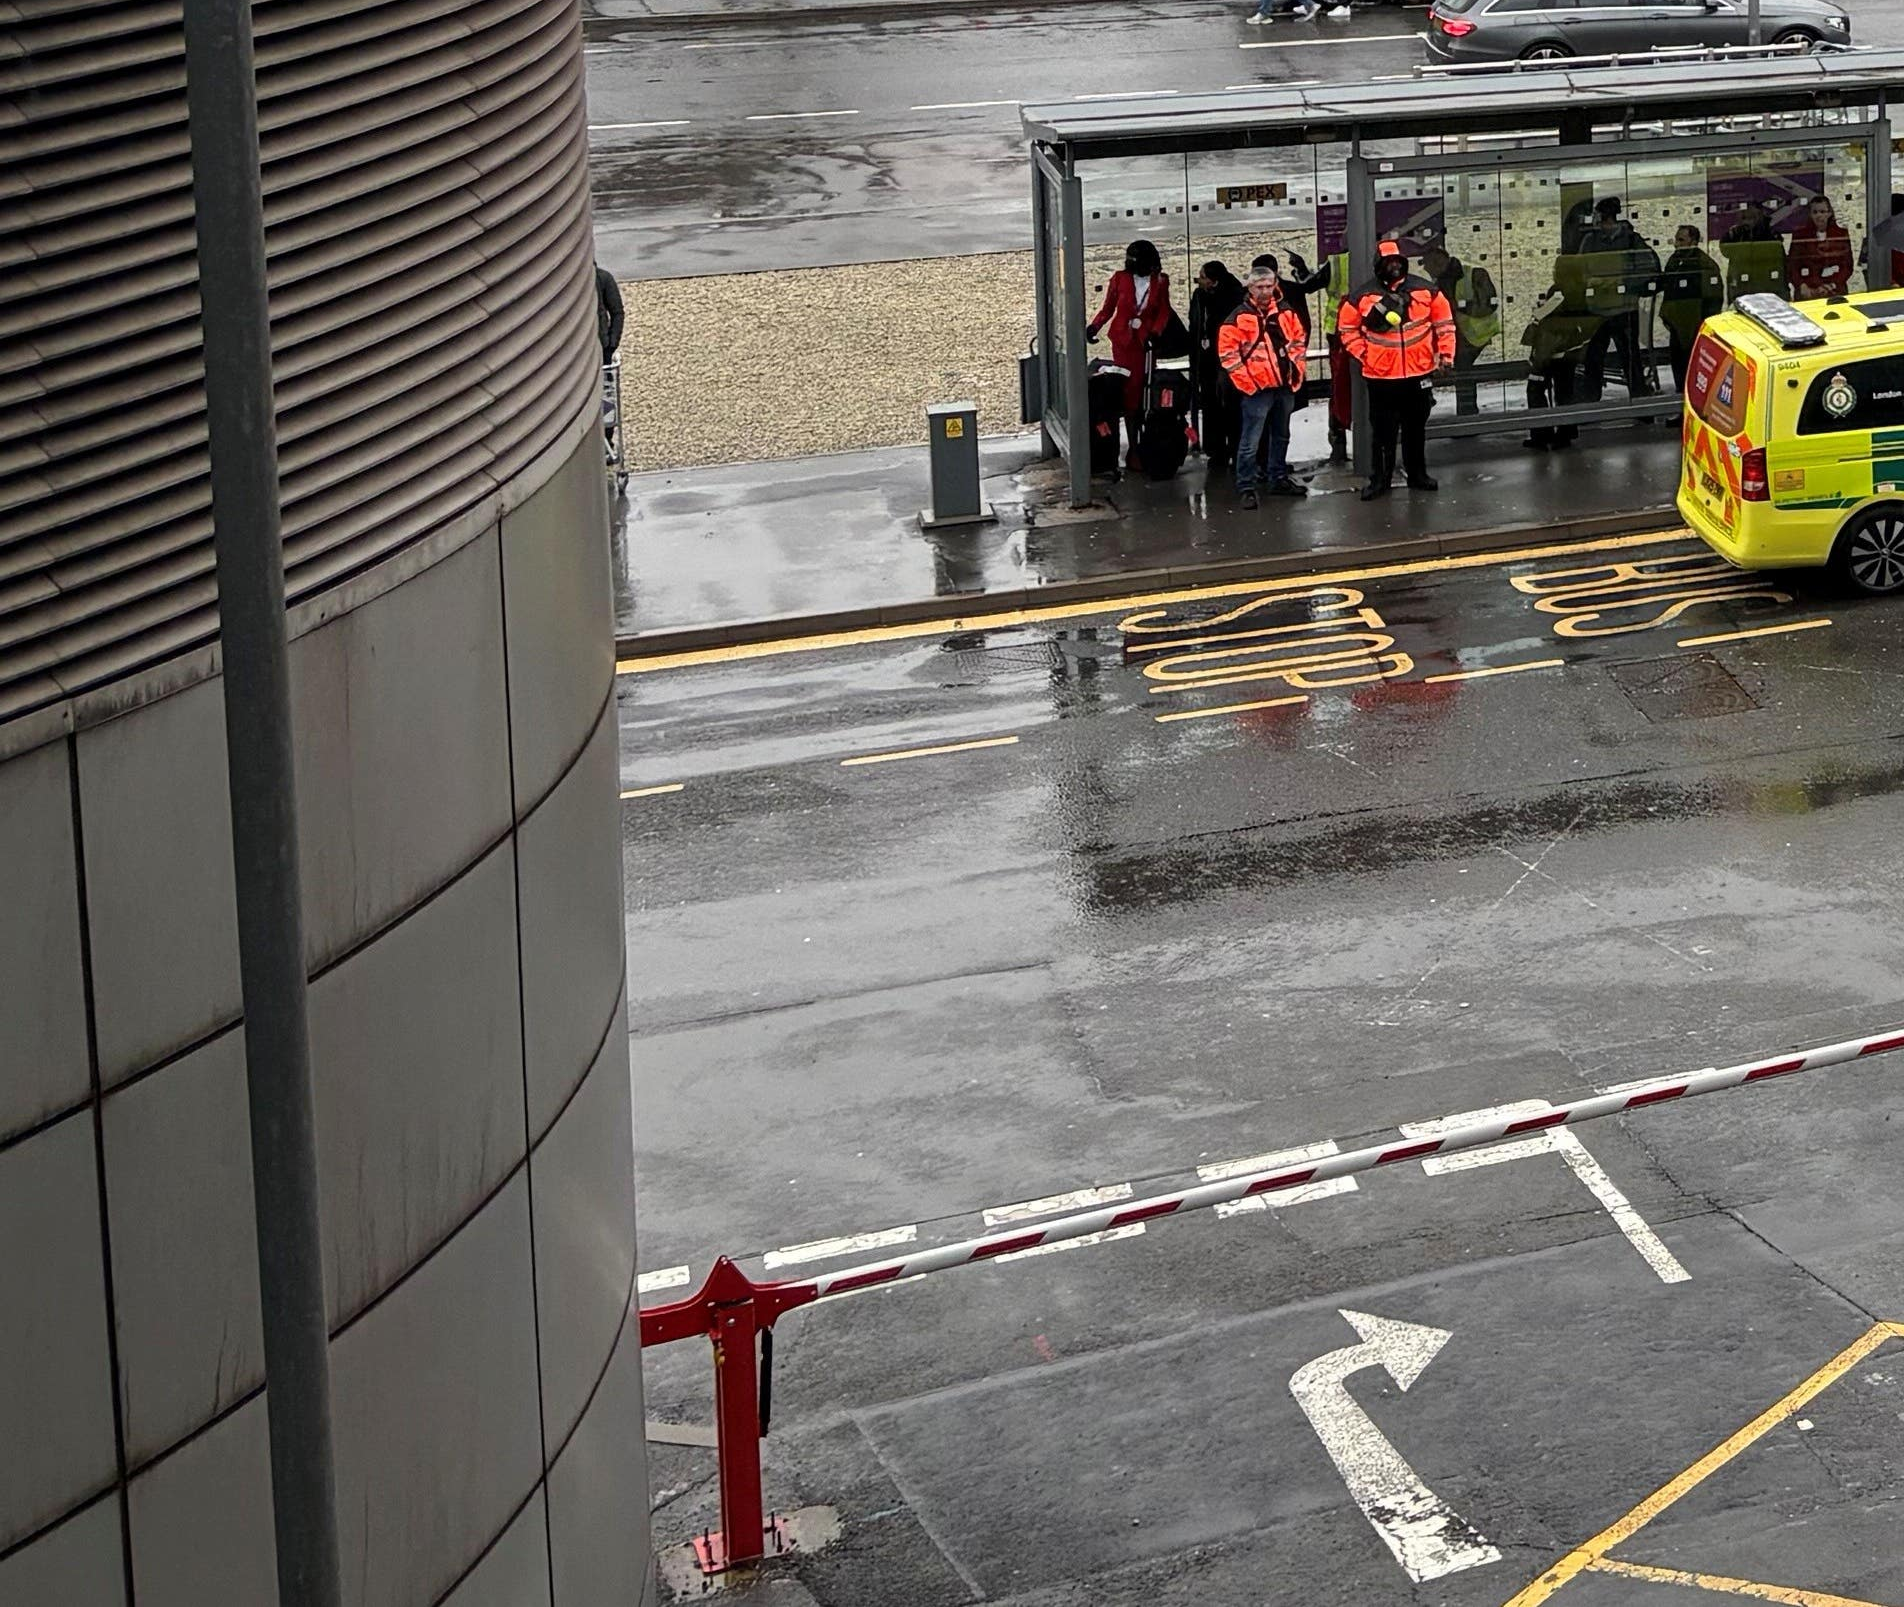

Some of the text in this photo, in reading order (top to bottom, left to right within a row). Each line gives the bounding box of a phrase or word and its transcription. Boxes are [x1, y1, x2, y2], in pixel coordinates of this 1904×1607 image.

[1246, 184, 1276, 200] PEX
[1872, 390, 1902, 400] London
[1510, 551, 1794, 637] BUS
[1116, 587, 1414, 694] STOP
